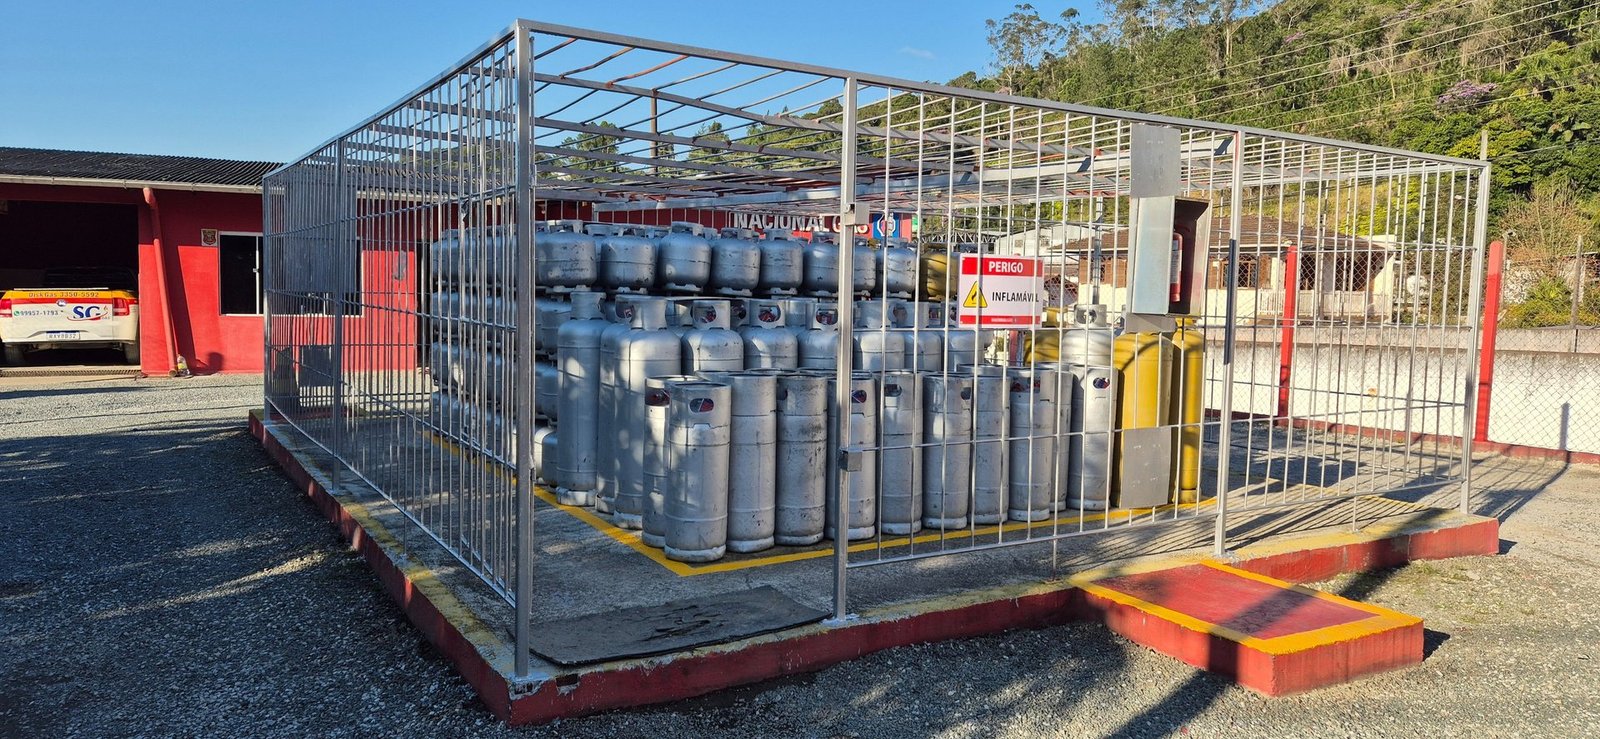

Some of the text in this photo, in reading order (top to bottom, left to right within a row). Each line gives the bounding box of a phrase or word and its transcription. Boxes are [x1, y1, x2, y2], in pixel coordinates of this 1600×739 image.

[733, 213, 869, 234] NACIONAL GS
[988, 261, 1023, 273] PERIGO
